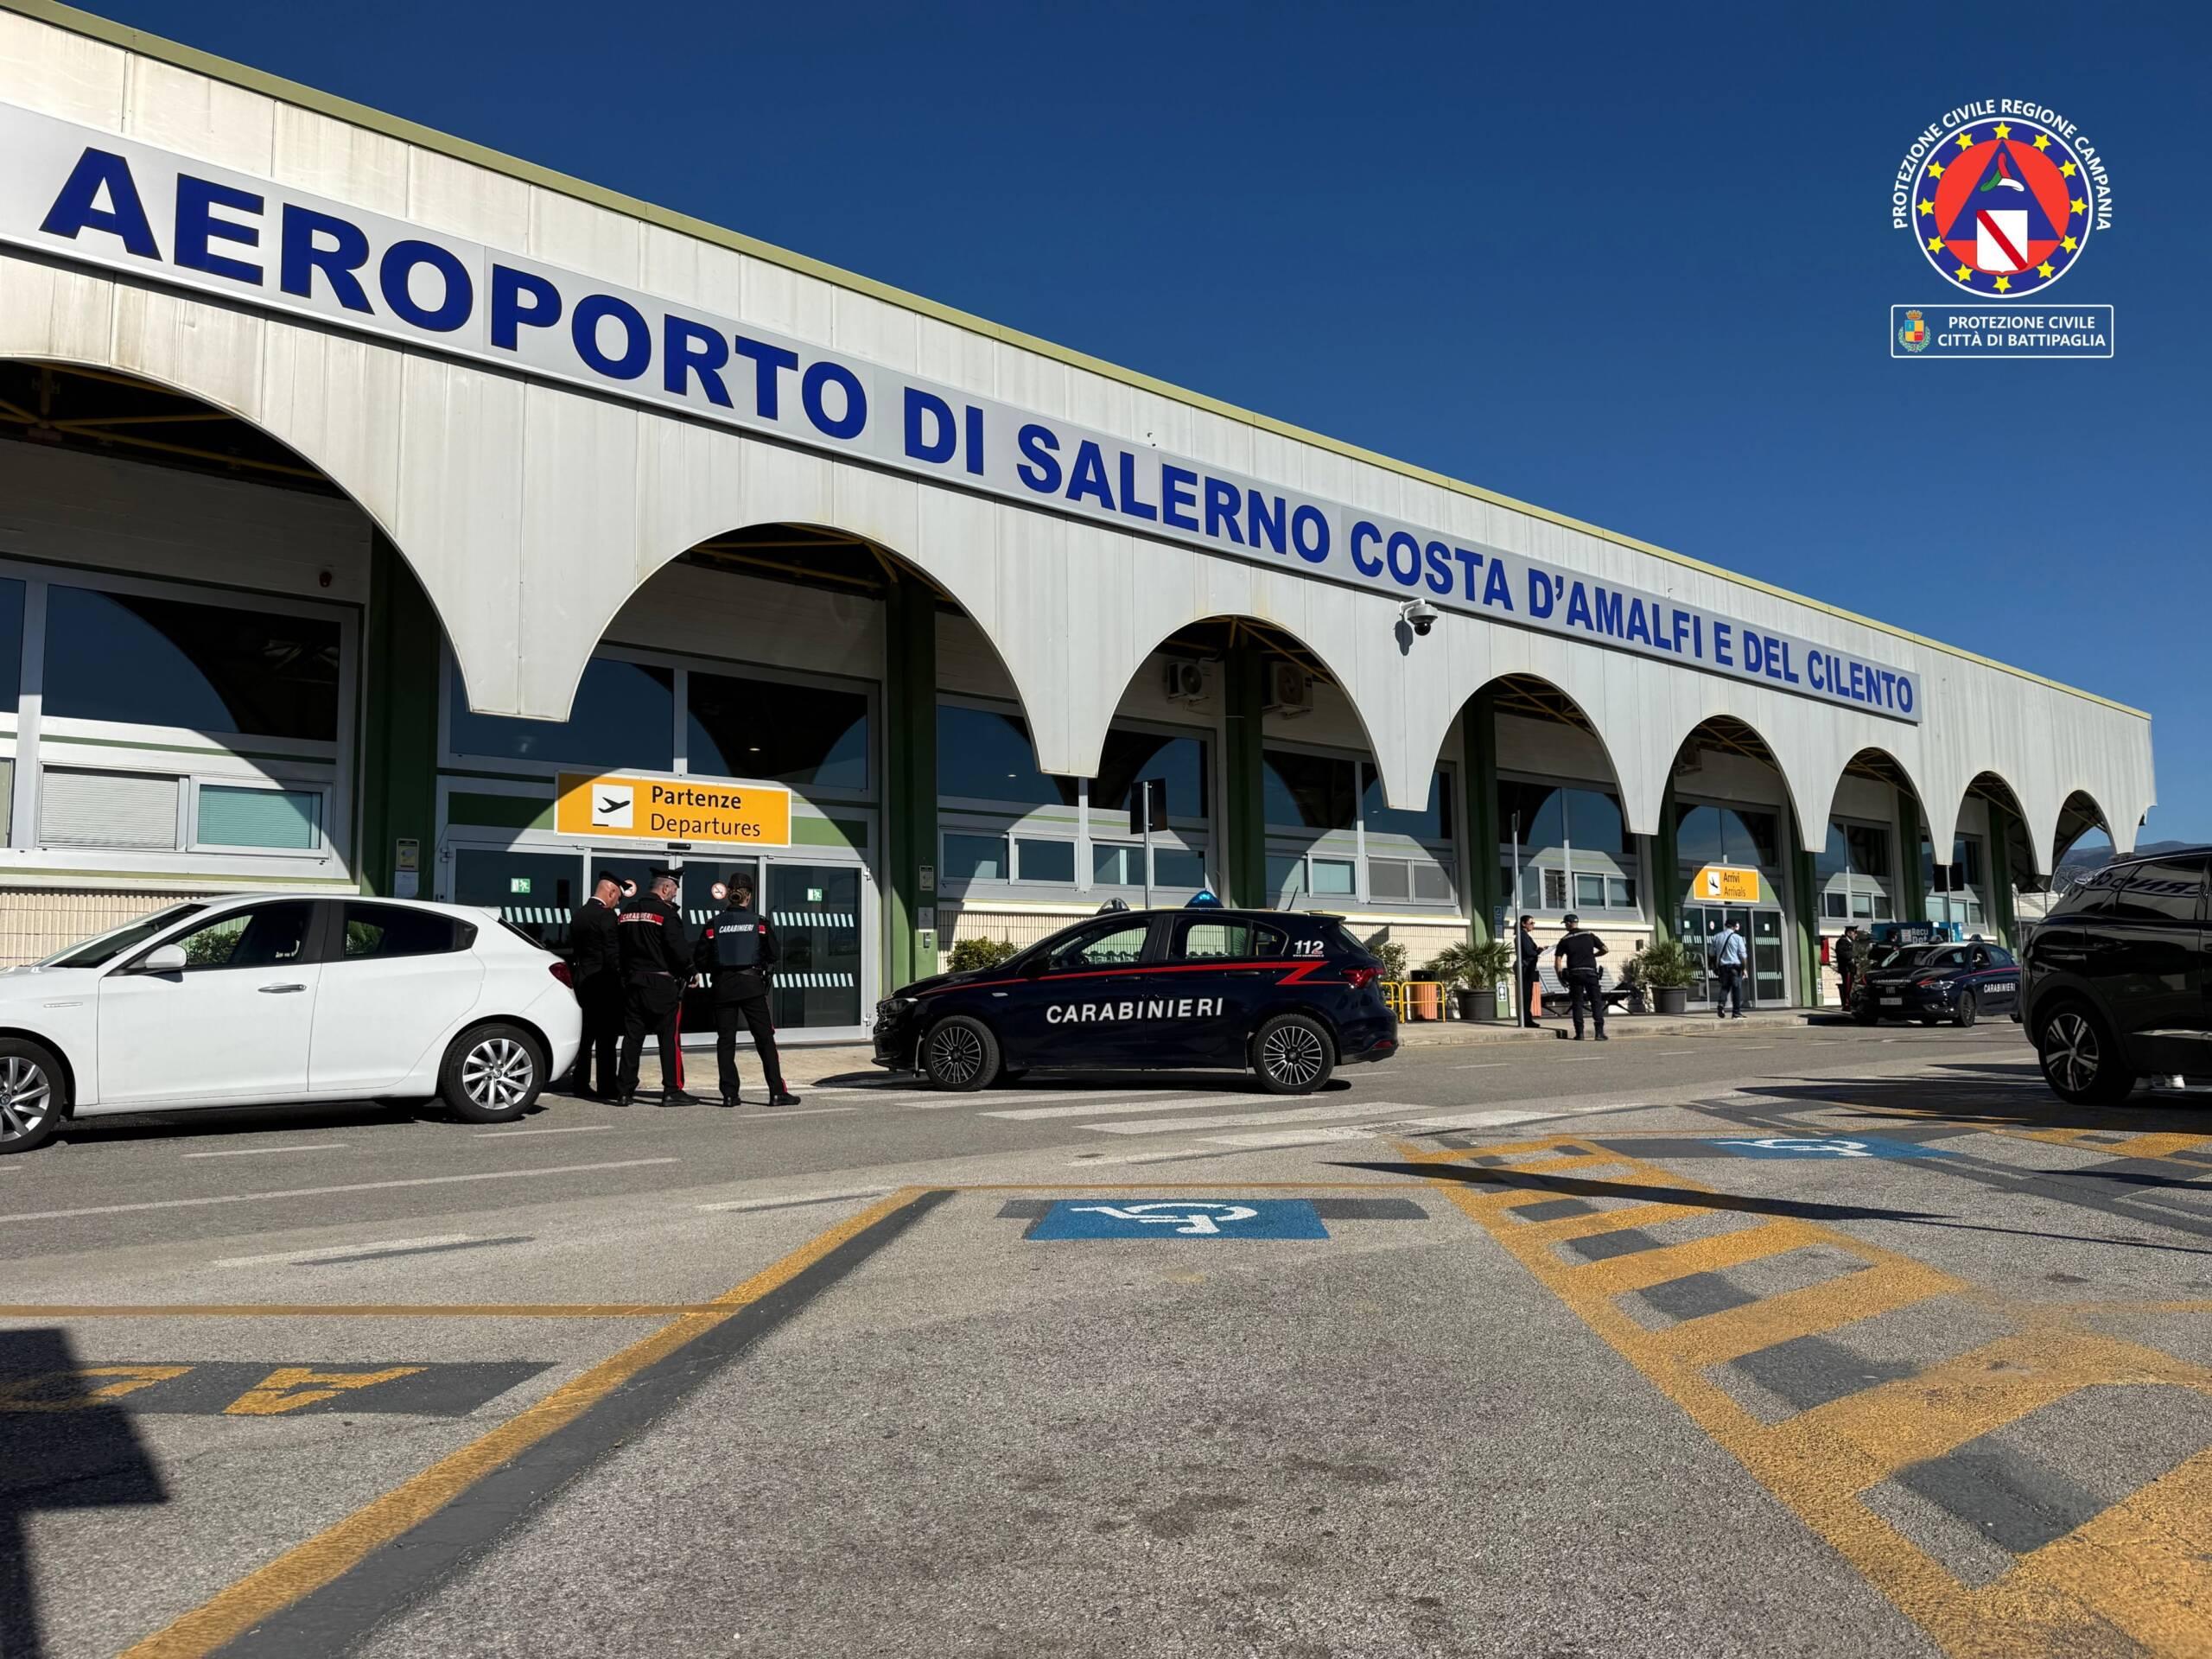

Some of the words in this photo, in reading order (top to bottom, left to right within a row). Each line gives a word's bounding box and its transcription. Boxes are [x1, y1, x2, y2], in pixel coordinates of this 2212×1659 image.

[39, 147, 867, 439] AEROPORTO
[905, 386, 983, 476] DI
[1016, 424, 1330, 563] SALERNO
[1351, 521, 1514, 611] COSTA
[1529, 568, 1702, 658] D'AMALFI
[1714, 621, 1733, 666] E
[1744, 630, 1799, 683] DEL
[1808, 650, 1913, 713] CILENTO
[652, 785, 741, 809] Partenze
[651, 813, 760, 838] Departures
[1723, 872, 1740, 884] Arrivi
[1724, 886, 1746, 897] Arrivals
[719, 924, 754, 933] CARABINIERI
[1294, 940, 1325, 954] 112
[1983, 982, 2016, 993] CARABINIERI
[1046, 998, 1224, 1024] CARABINIERI
